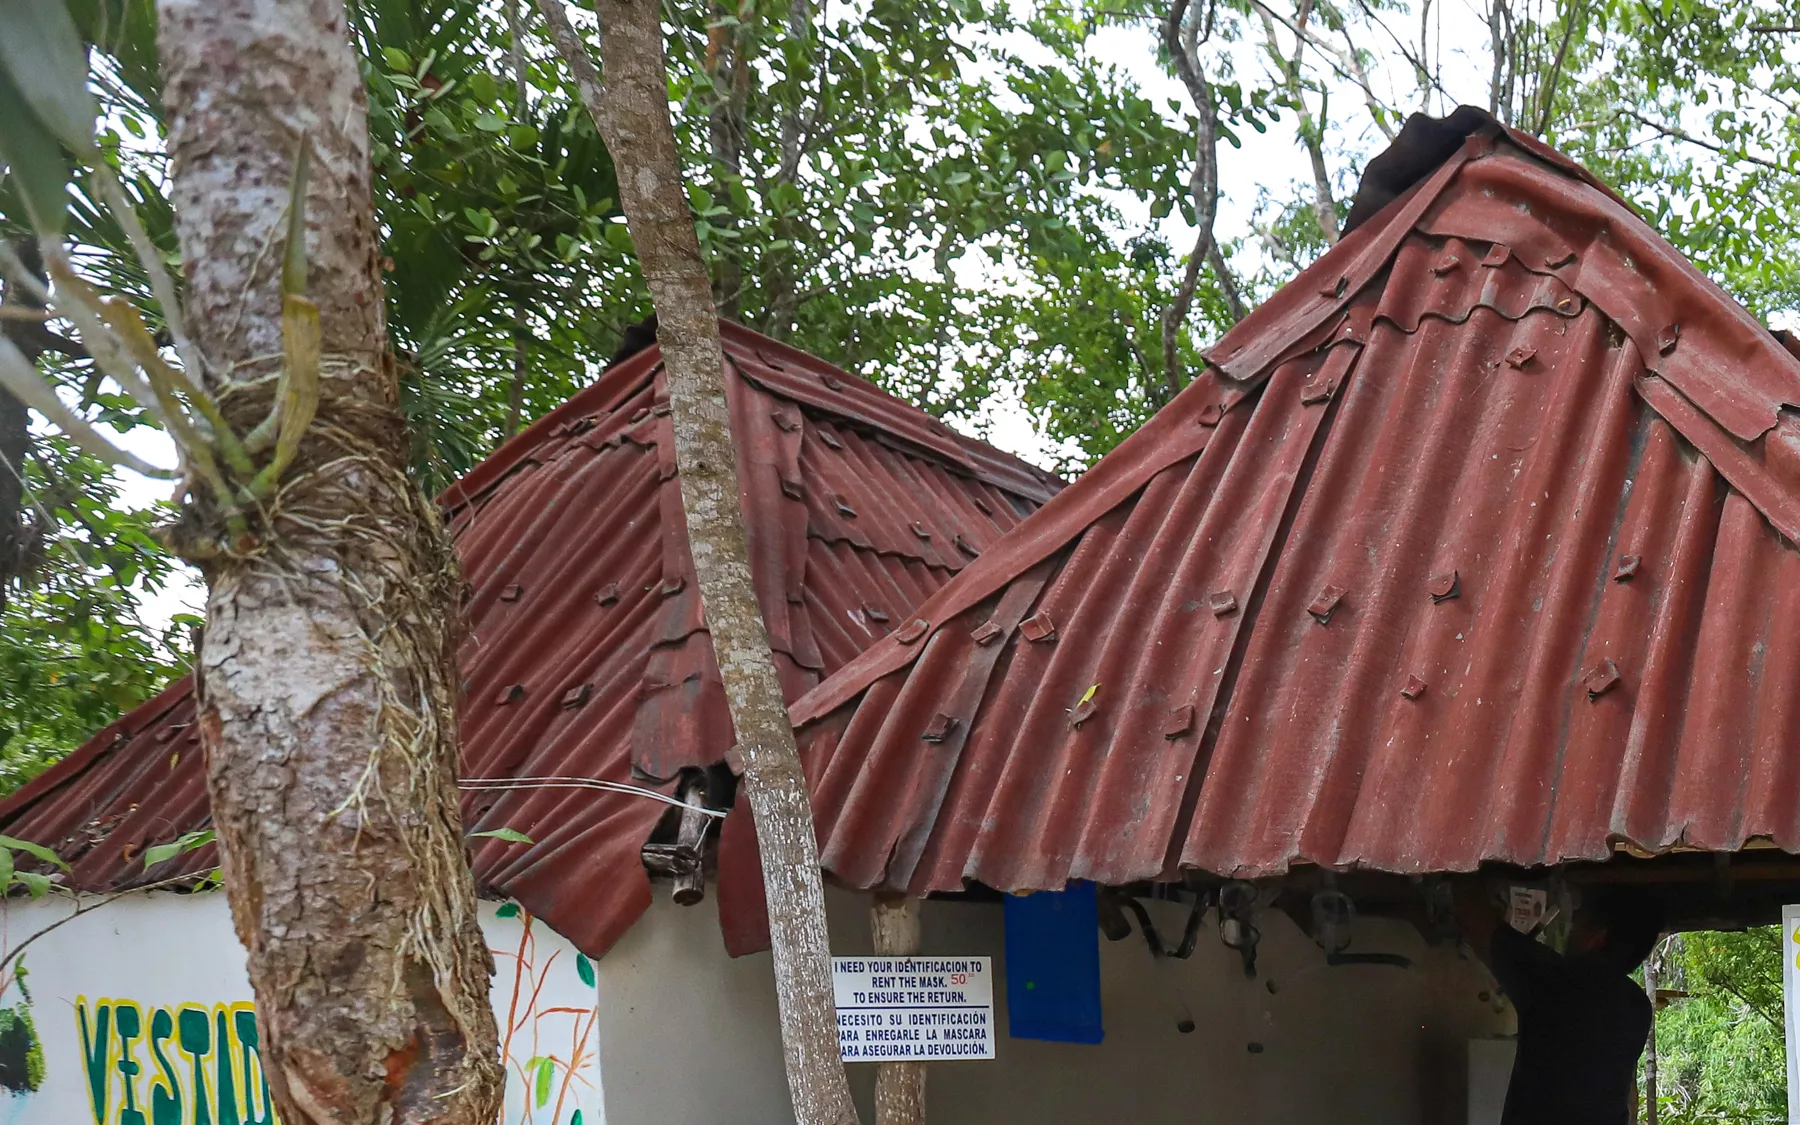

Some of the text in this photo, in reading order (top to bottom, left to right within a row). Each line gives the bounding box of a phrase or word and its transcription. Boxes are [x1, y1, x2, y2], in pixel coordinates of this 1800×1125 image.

[839, 961, 968, 973] NEED YOUR IDENTIFICACION
[872, 976, 947, 988] RENT THE MASK.
[868, 991, 966, 1003] ENSURE THE RETURN.
[889, 1011, 986, 1026] SU IDENTIFICACIÓN
[866, 1028, 986, 1041] ENREGARLE MASCARA
[862, 1041, 987, 1056] ASEGURAR DEVOLUCIÓN.
